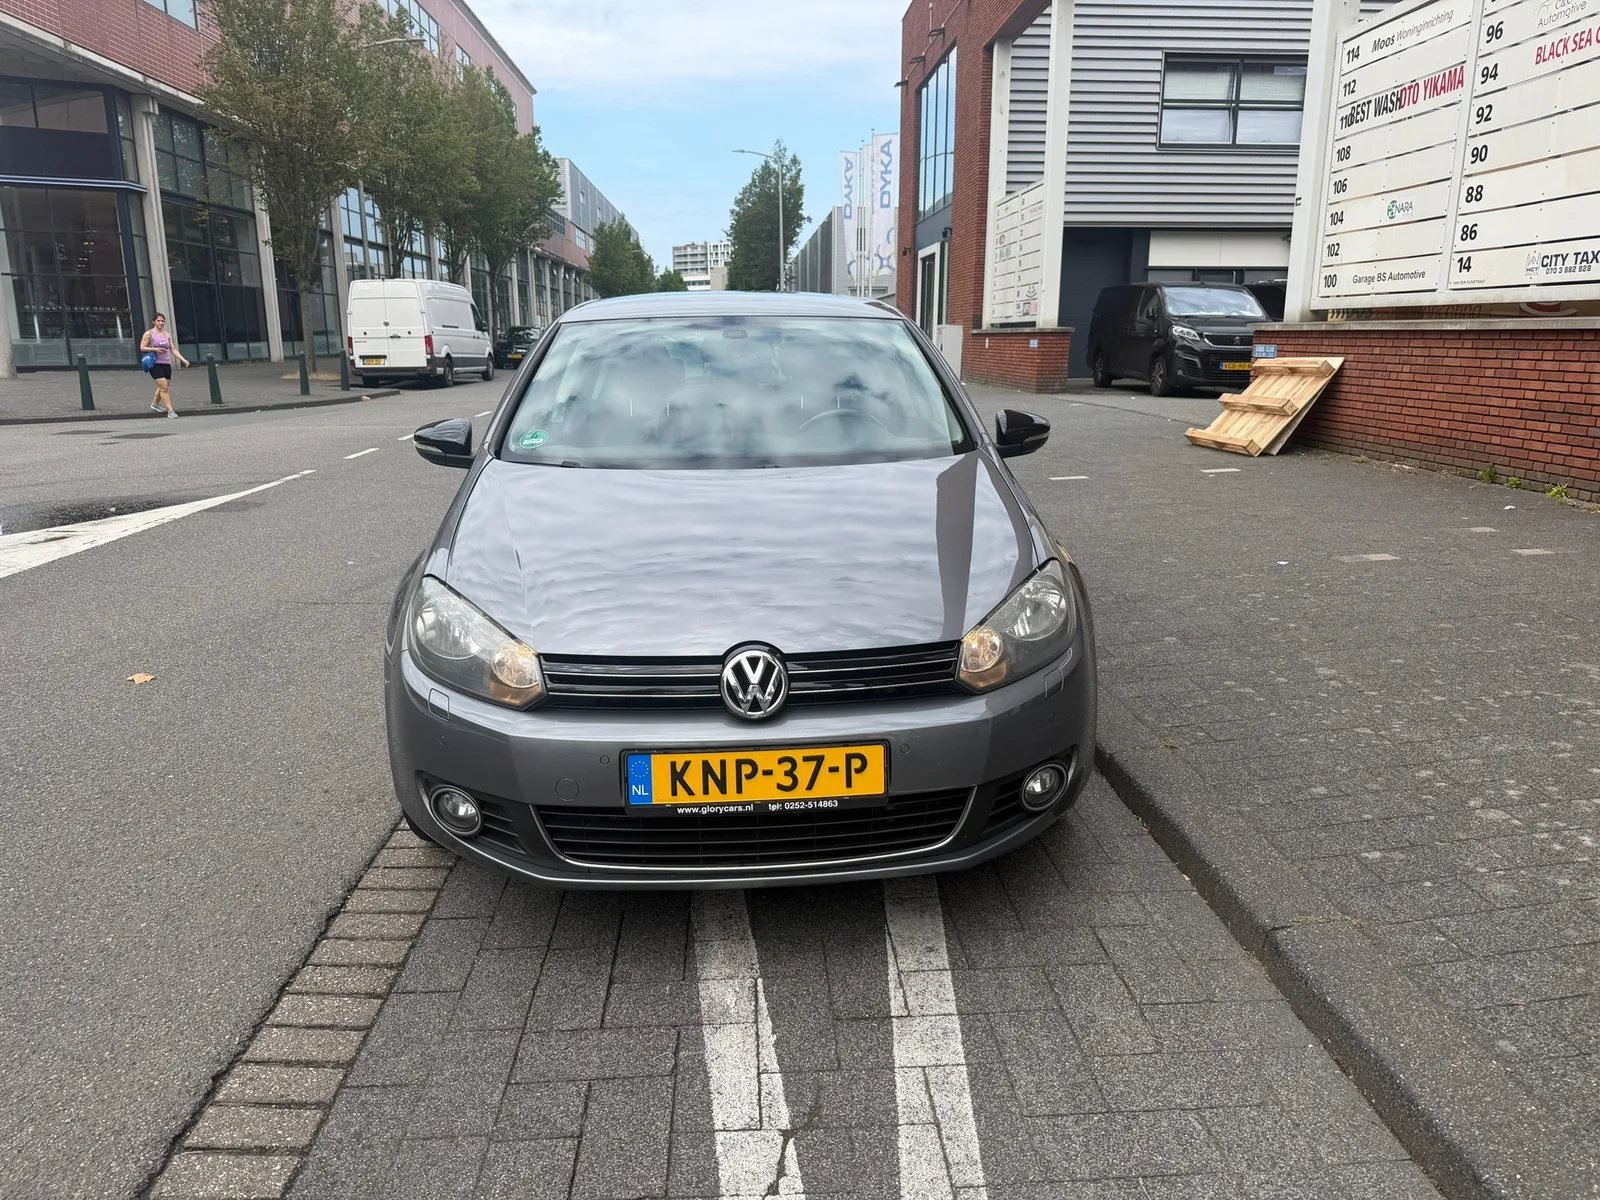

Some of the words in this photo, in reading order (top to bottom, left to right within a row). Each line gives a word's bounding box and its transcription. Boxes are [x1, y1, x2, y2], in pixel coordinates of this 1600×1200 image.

[1537, 1, 1587, 29] Automotive
[1371, 34, 1395, 53] Moos
[1396, 9, 1454, 41] Woninginrichting
[1486, 21, 1504, 44] 96
[1346, 45, 1360, 64] 114
[1535, 36, 1571, 65] BLACK
[1571, 28, 1592, 53] SEA
[1481, 63, 1498, 85] 94
[1343, 79, 1357, 97] 112
[1400, 82, 1420, 109] OTO
[1423, 65, 1465, 101] YIKAMA
[1350, 98, 1372, 125] BEST
[1374, 90, 1401, 118] WASH
[1475, 104, 1493, 125] 92
[1336, 145, 1351, 163] 108
[1470, 144, 1488, 165] 90
[880, 139, 892, 209] DYKA
[1333, 178, 1347, 195] 106
[1465, 184, 1484, 204] 88
[1330, 211, 1344, 226] 104
[1460, 223, 1478, 242] 86
[1327, 242, 1340, 258] 102
[1457, 256, 1472, 273] 14
[1541, 252, 1569, 268] CITY
[1352, 274, 1375, 285] Garage
[1376, 272, 1387, 282] BS
[1388, 269, 1426, 281] Automotive
[1546, 267, 1557, 275] 070
[1323, 274, 1337, 288] 100
[670, 752, 868, 797] KNP-37-P
[632, 784, 649, 795] NL
[676, 803, 754, 815] www.glorycars.nl
[784, 799, 838, 810] 0252-514863
